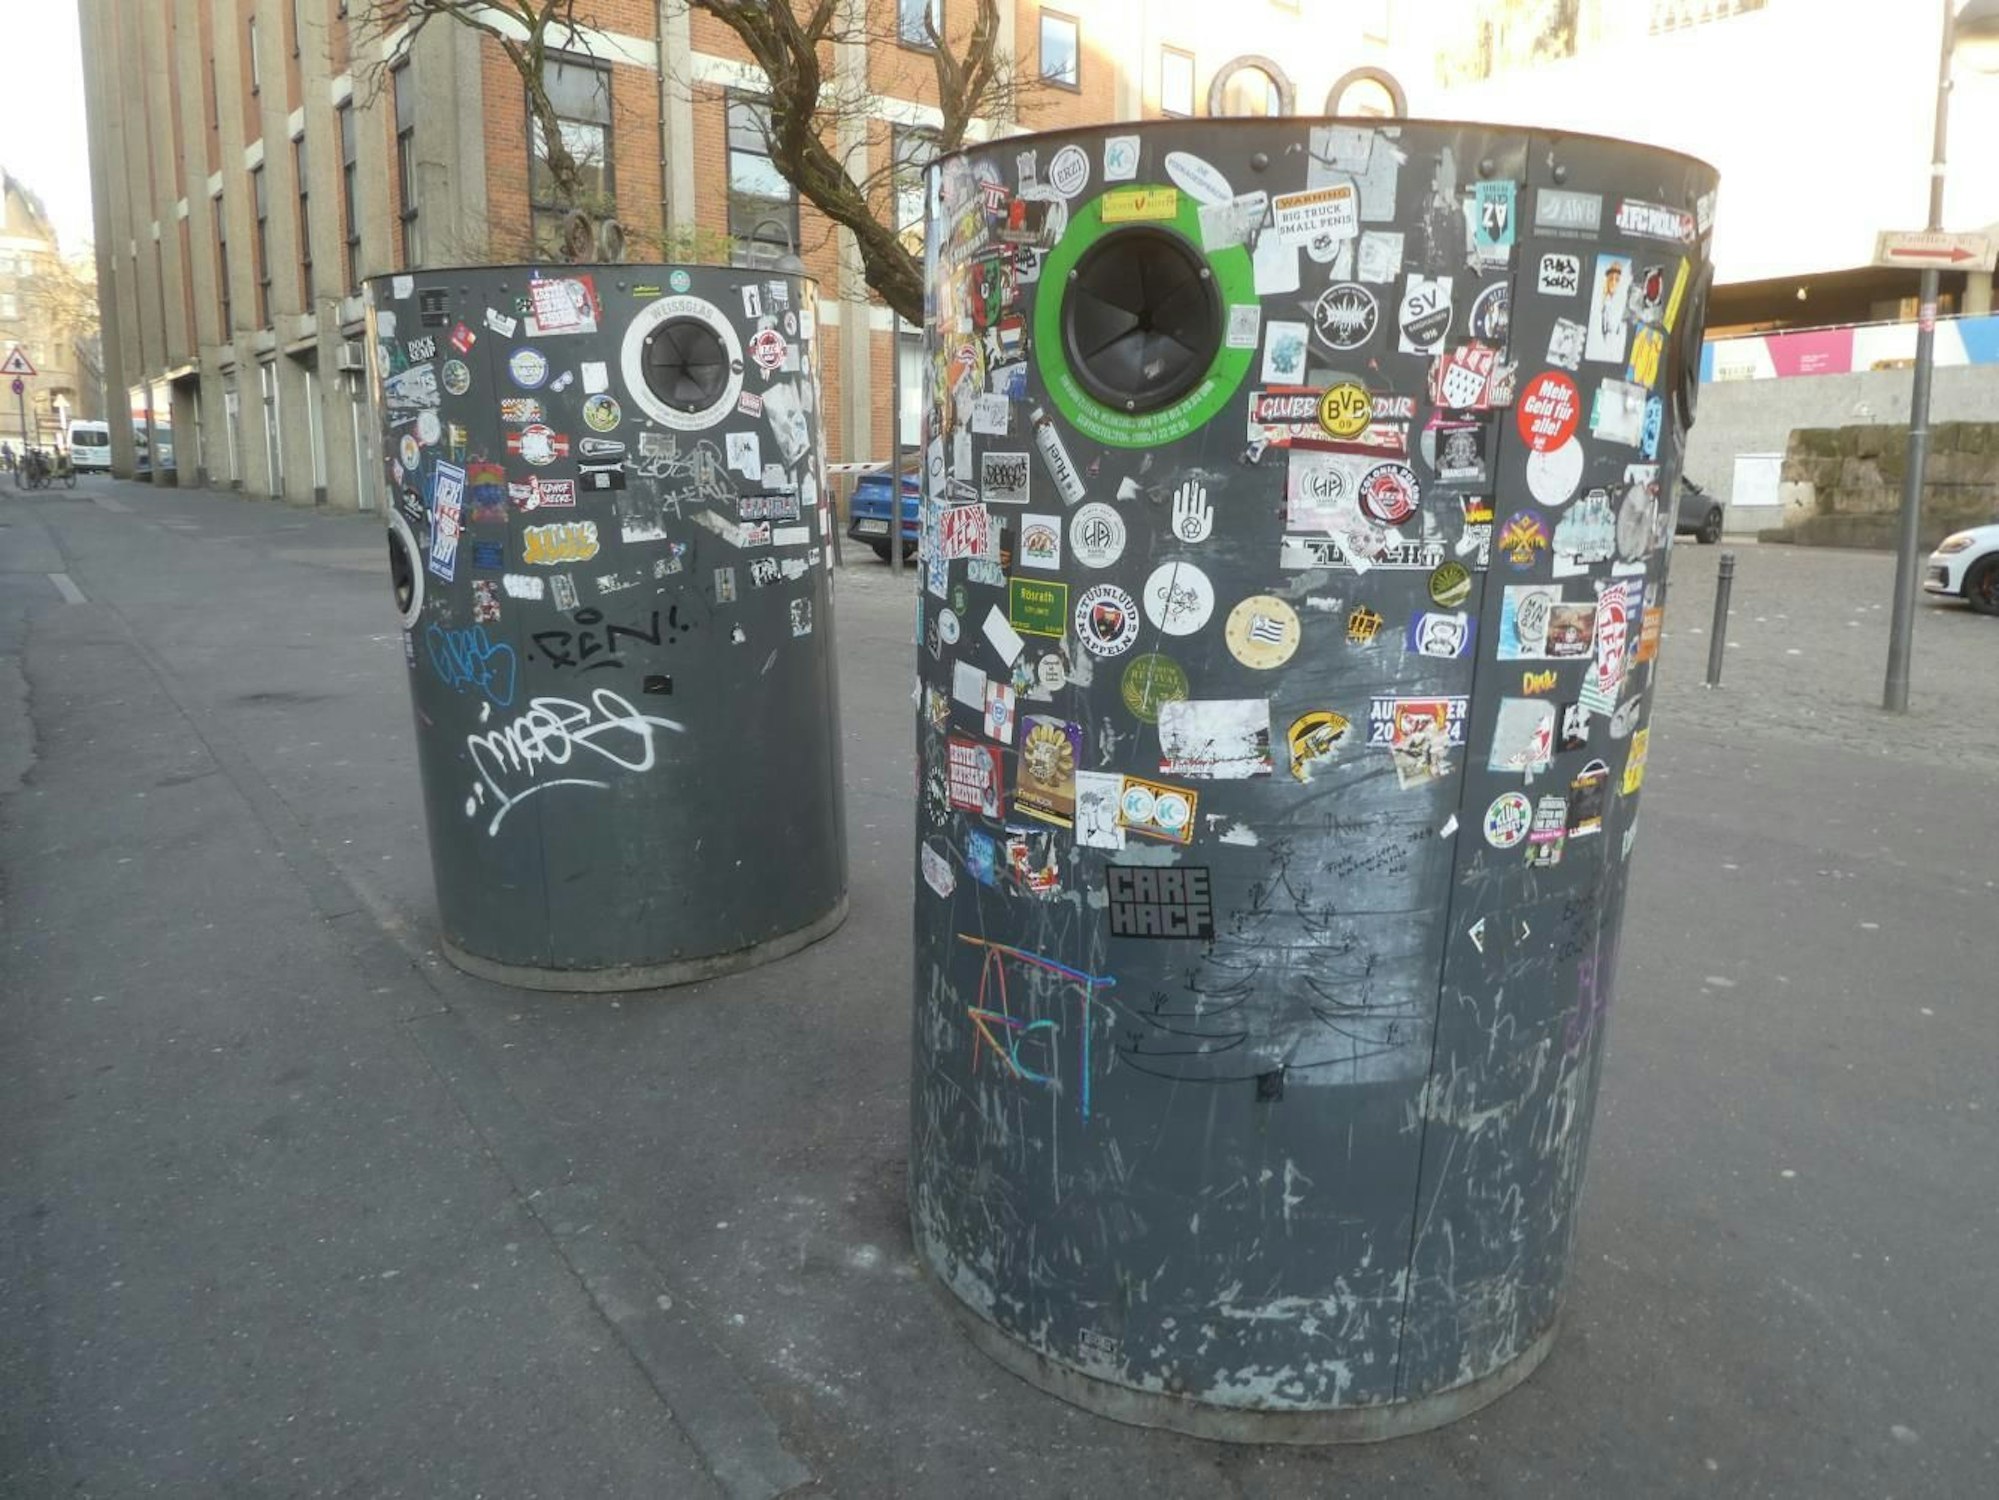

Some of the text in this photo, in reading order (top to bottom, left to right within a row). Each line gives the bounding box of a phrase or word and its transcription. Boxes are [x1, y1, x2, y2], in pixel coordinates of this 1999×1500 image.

[1280, 215, 1351, 235] SMALL PENIS
[1283, 204, 1341, 222] BIG TRUCK
[1408, 289, 1436, 316] SV
[1539, 380, 1573, 400] Mehr
[1524, 395, 1574, 420] Geld für
[1531, 417, 1562, 437] alle!
[1047, 443, 1070, 482] Huel
[1078, 622, 1132, 655] KAPPELN
[1107, 868, 1209, 899] CARE
